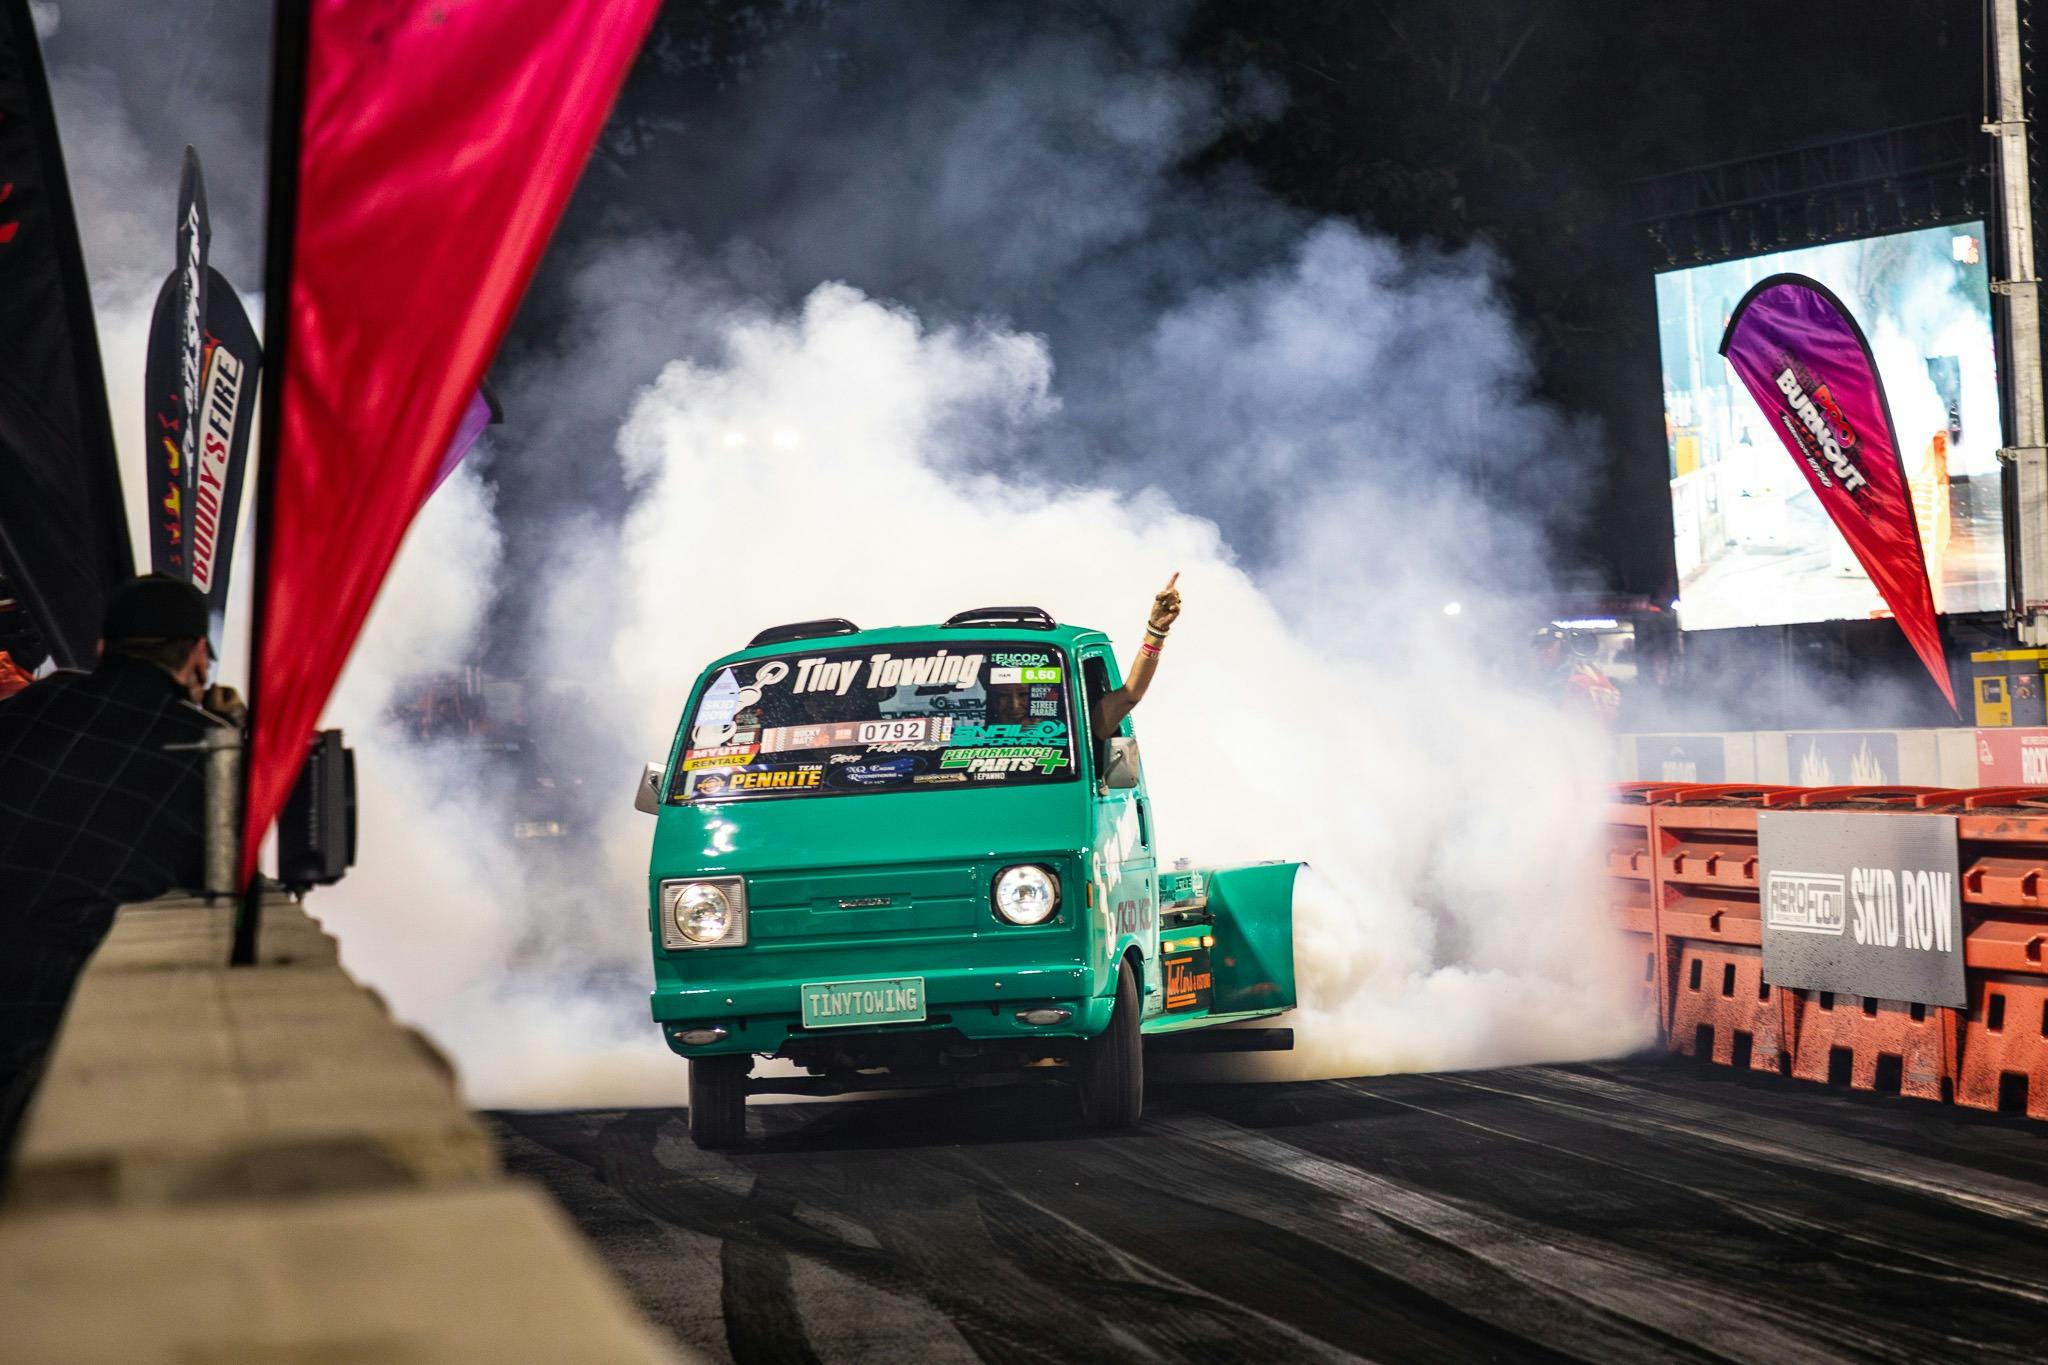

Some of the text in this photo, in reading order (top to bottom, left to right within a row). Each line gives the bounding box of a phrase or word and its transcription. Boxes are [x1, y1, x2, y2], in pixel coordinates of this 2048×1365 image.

[1811, 384, 1857, 449] PRO
[1776, 367, 1867, 492] BURNOUT
[793, 650, 985, 696] Tiny Towing
[1030, 700, 1058, 709] STREET
[1030, 708, 1057, 717] PARADE
[864, 722, 920, 741] 0792
[691, 756, 747, 769] RENTALS
[941, 747, 1052, 760] PERFORMANCE
[967, 758, 1036, 772] PARTS
[728, 769, 823, 790] PENRITE
[1851, 867, 1952, 953] SKID ROW
[809, 987, 918, 1018] TINYTOWING
